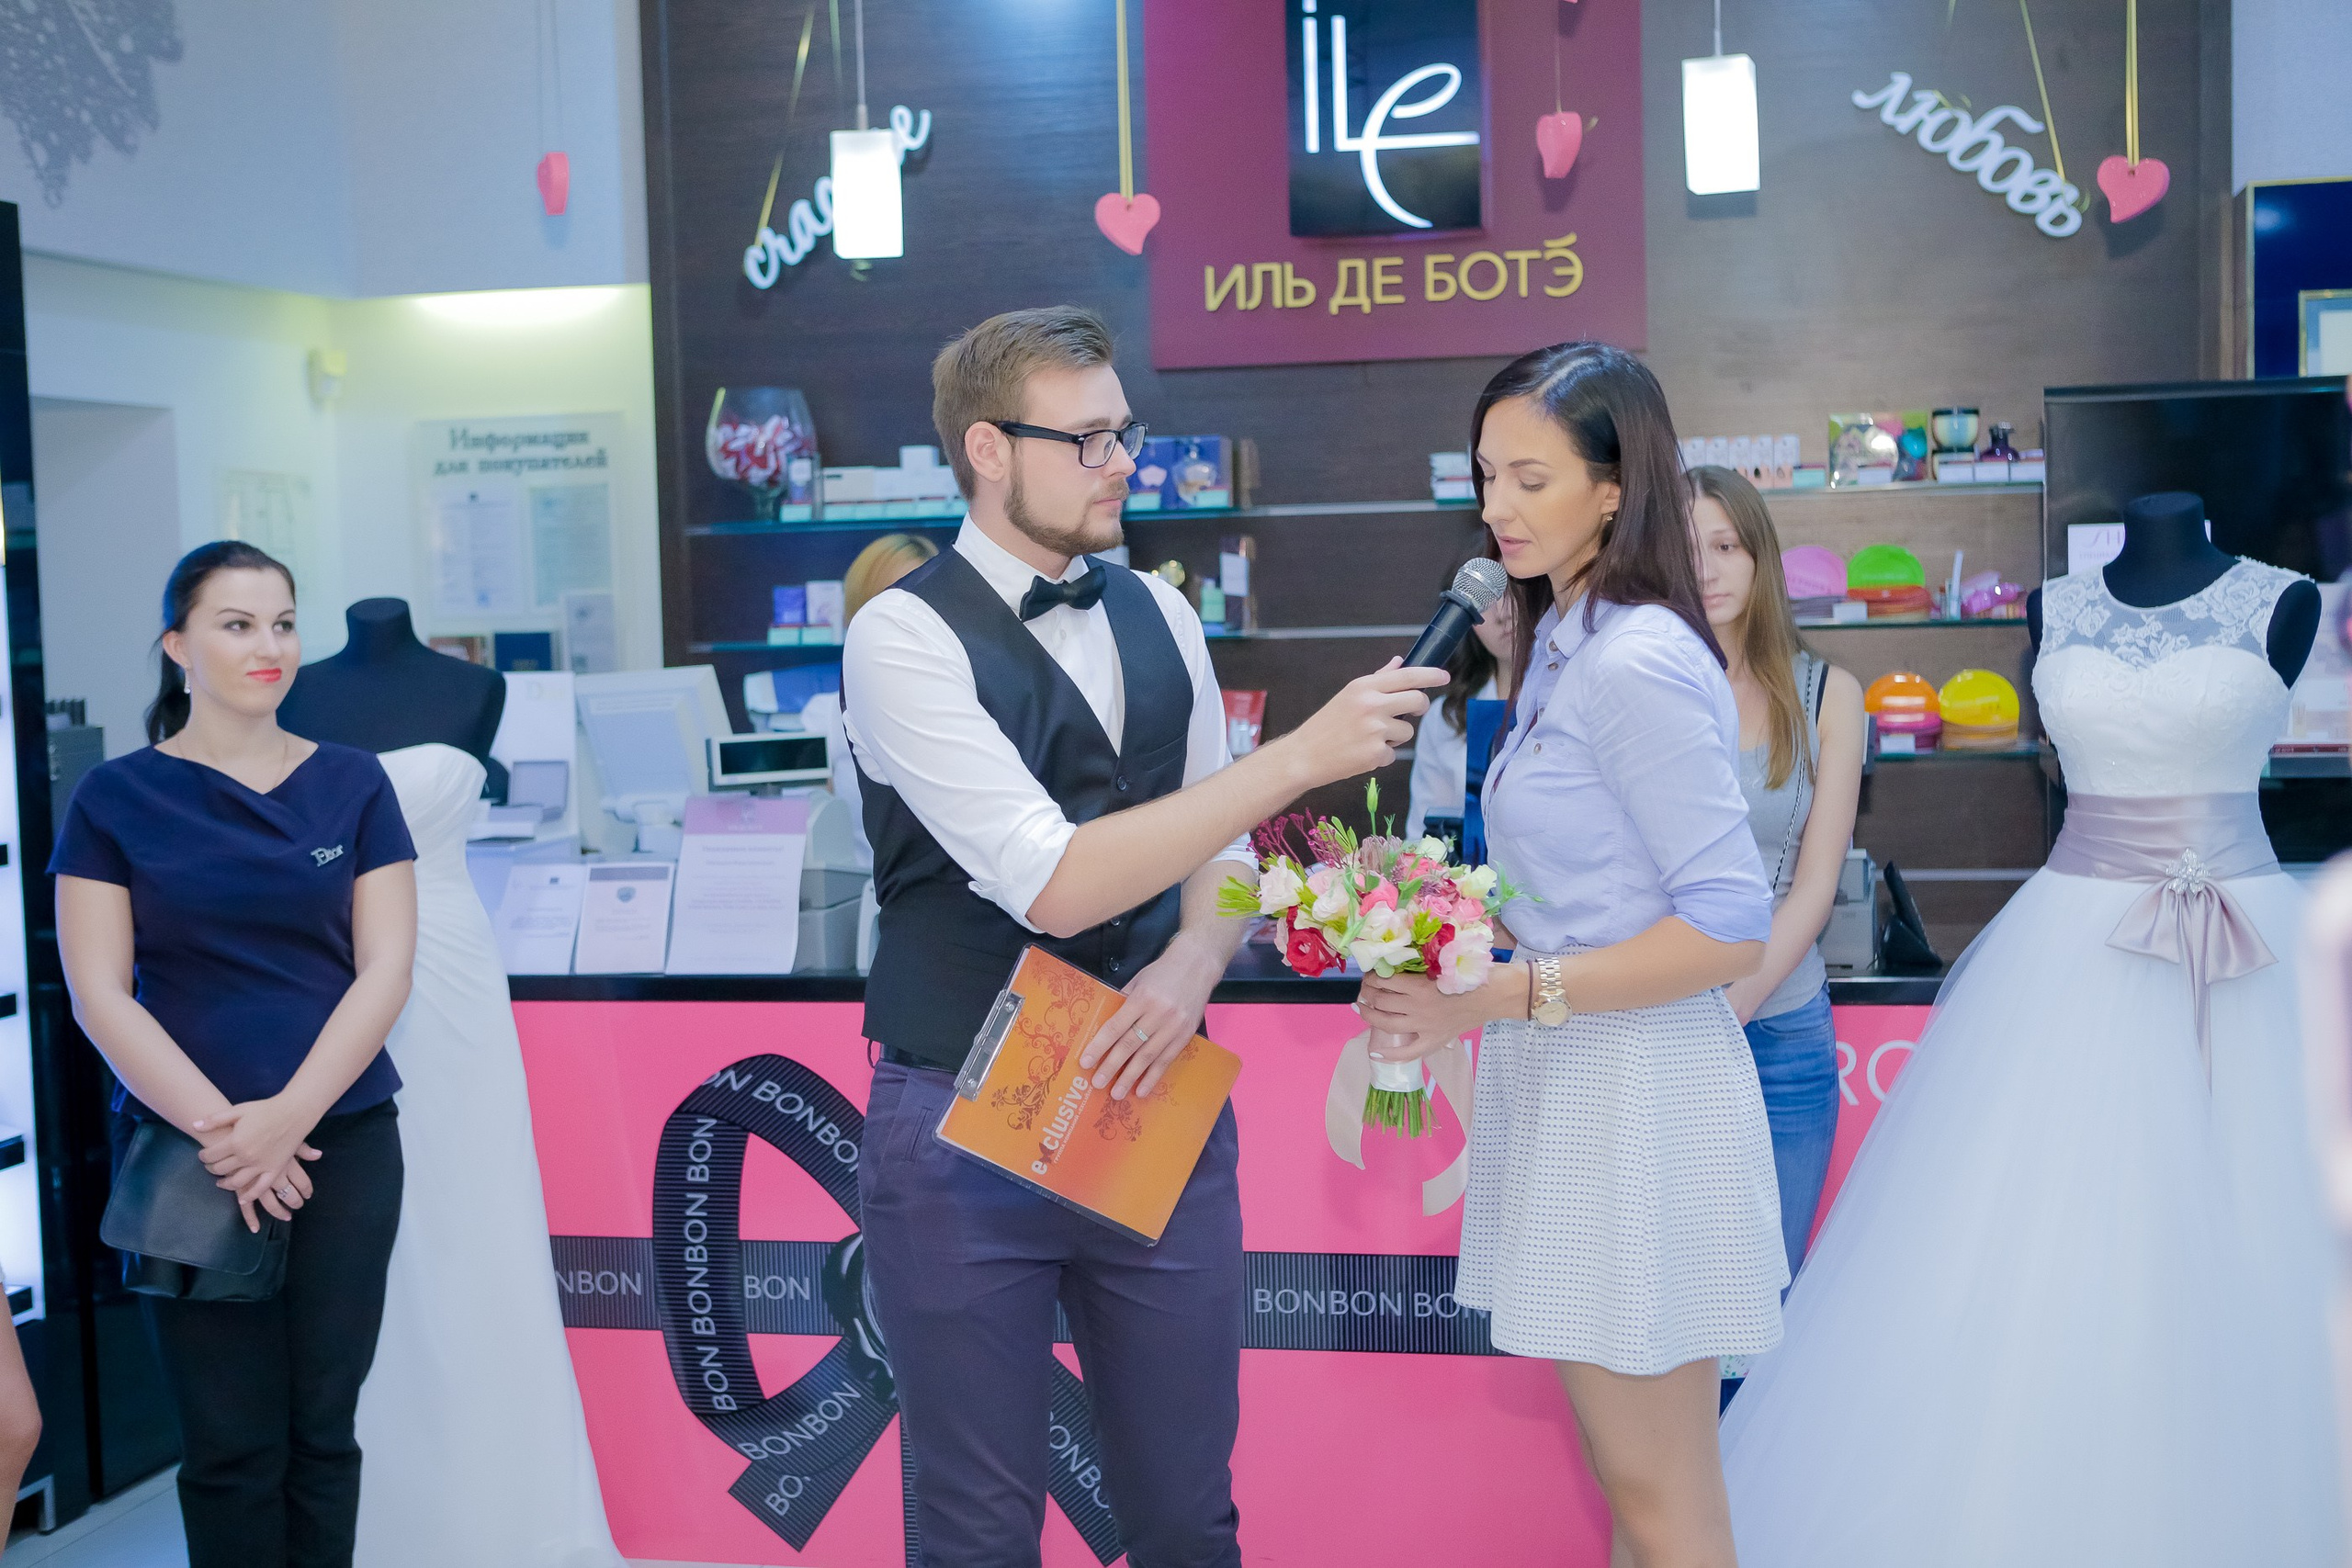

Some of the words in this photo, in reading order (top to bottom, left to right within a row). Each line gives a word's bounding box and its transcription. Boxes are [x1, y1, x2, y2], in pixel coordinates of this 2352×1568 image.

[1851, 72, 2083, 237] любовь
[1204, 262, 1317, 311] ИЛЬ
[1329, 256, 1407, 315] ДЕ
[311, 845, 344, 867] Dior
[685, 1118, 718, 1182] BON
[752, 1079, 860, 1173] BONBO
[684, 1192, 718, 1336] BONBON
[743, 1274, 810, 1301] BON
[1255, 1288, 1403, 1318] BONBON
[1414, 1290, 1487, 1320] BO
[695, 1346, 739, 1412] BON
[737, 1382, 862, 1461] BONBON
[764, 1474, 812, 1517] BO
